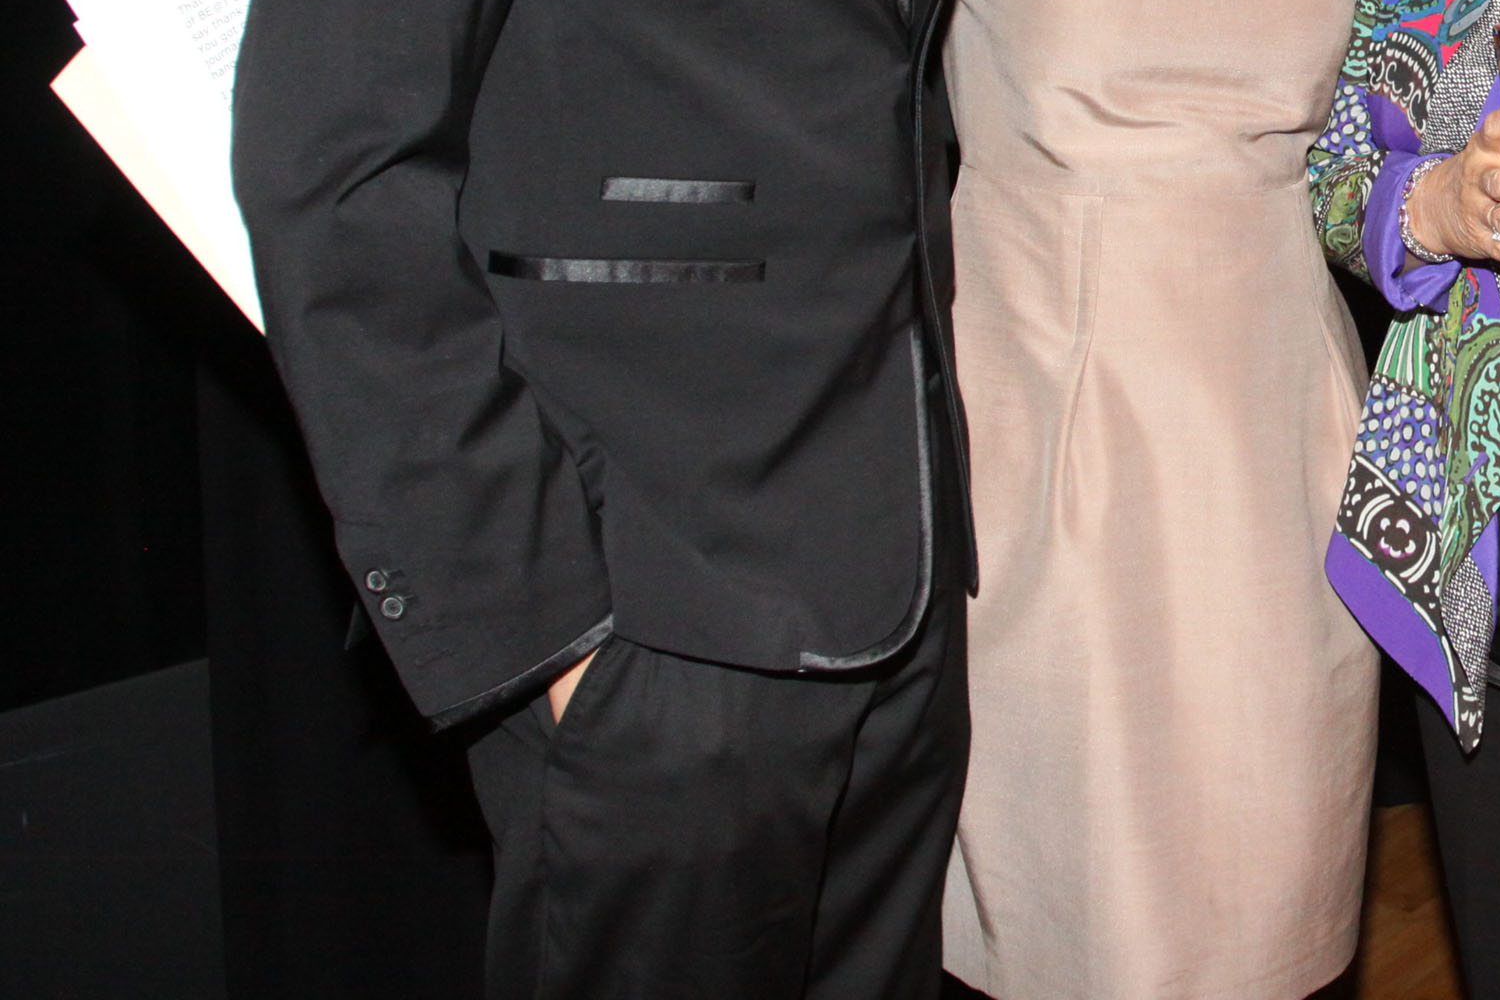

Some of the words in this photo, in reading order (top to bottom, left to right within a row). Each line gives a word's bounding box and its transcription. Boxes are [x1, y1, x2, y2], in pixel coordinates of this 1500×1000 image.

[191, 26, 208, 43] say
[211, 6, 242, 31] thank
[197, 38, 218, 54] You
